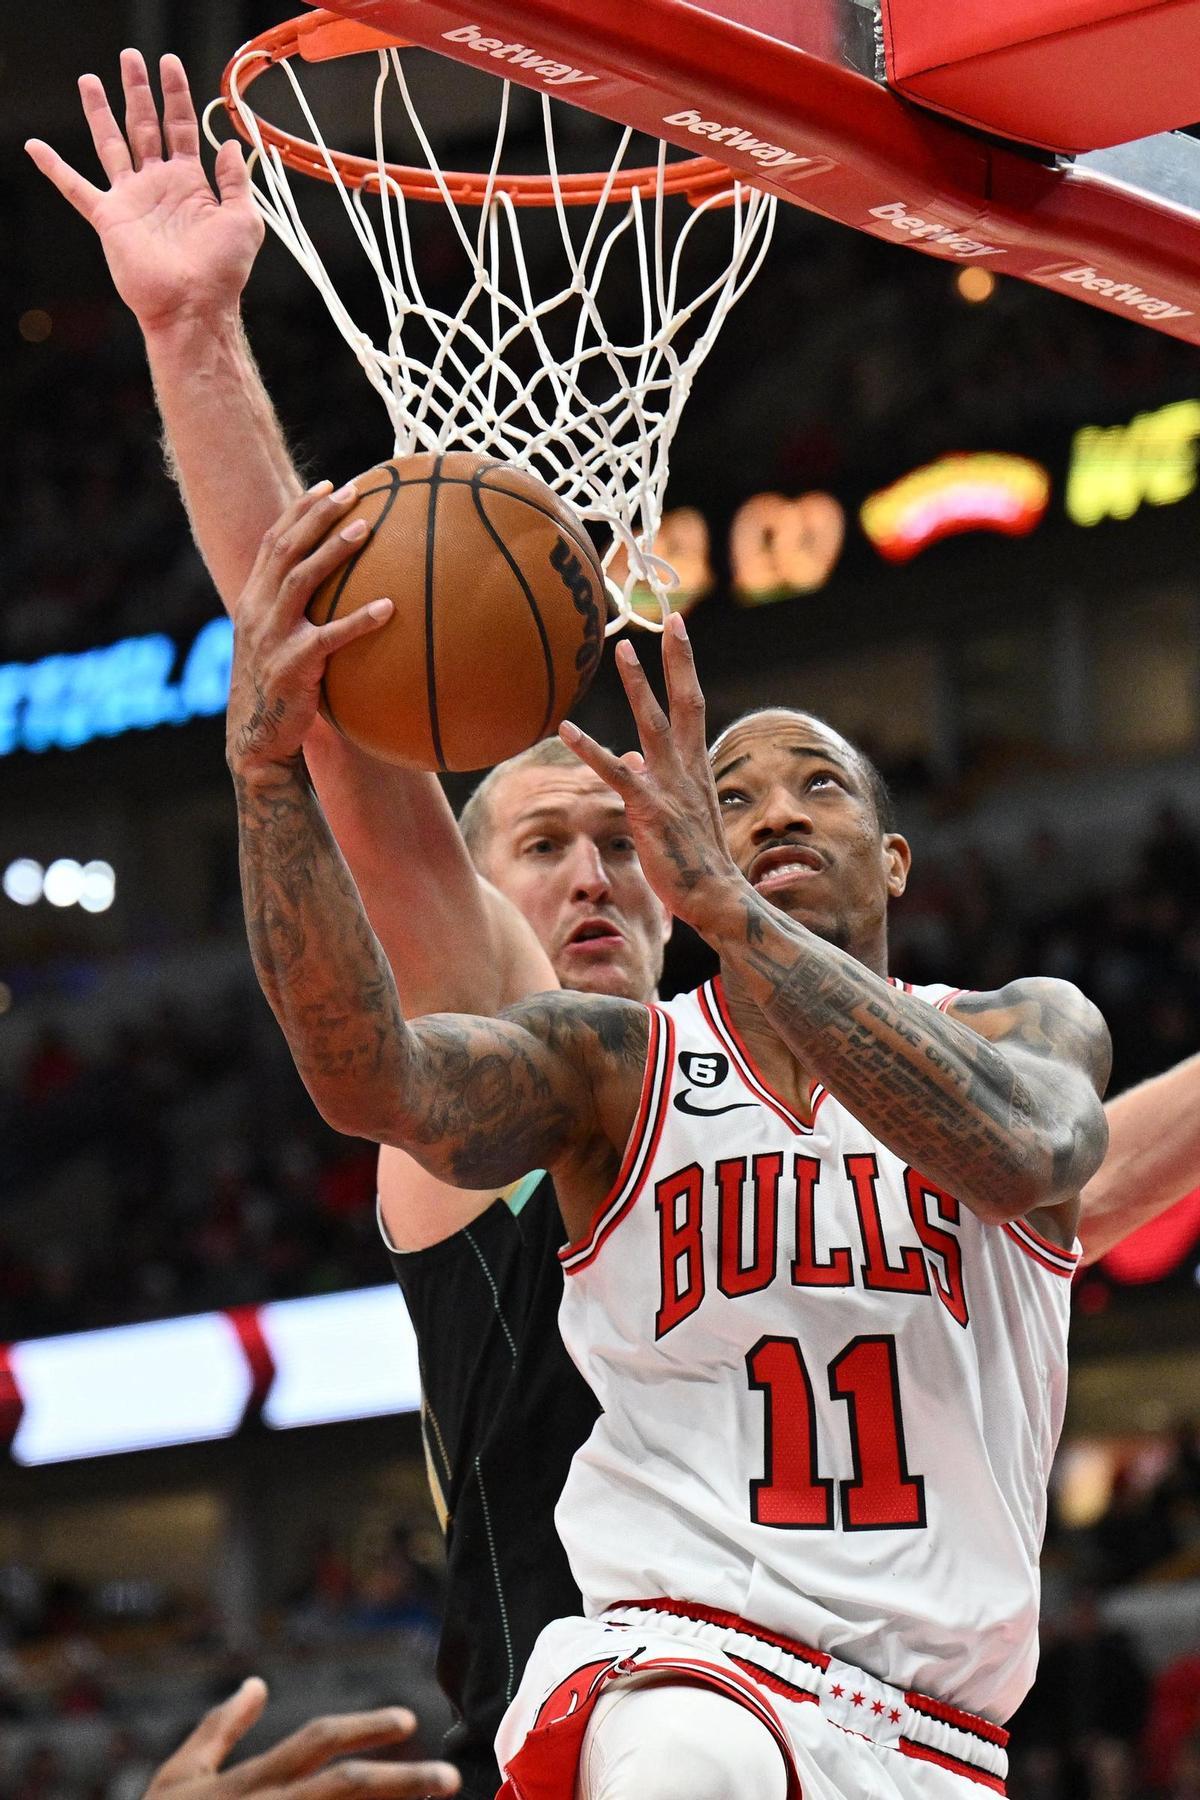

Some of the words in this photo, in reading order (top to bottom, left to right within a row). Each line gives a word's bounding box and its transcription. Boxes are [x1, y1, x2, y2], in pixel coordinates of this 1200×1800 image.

[441, 24, 600, 85] betway
[662, 109, 812, 167] betway
[868, 201, 1008, 258] betway
[1059, 267, 1195, 320] betway
[688, 1056, 718, 1085] 6
[654, 1150, 970, 1342] BULLS
[744, 1334, 928, 1532] 11
